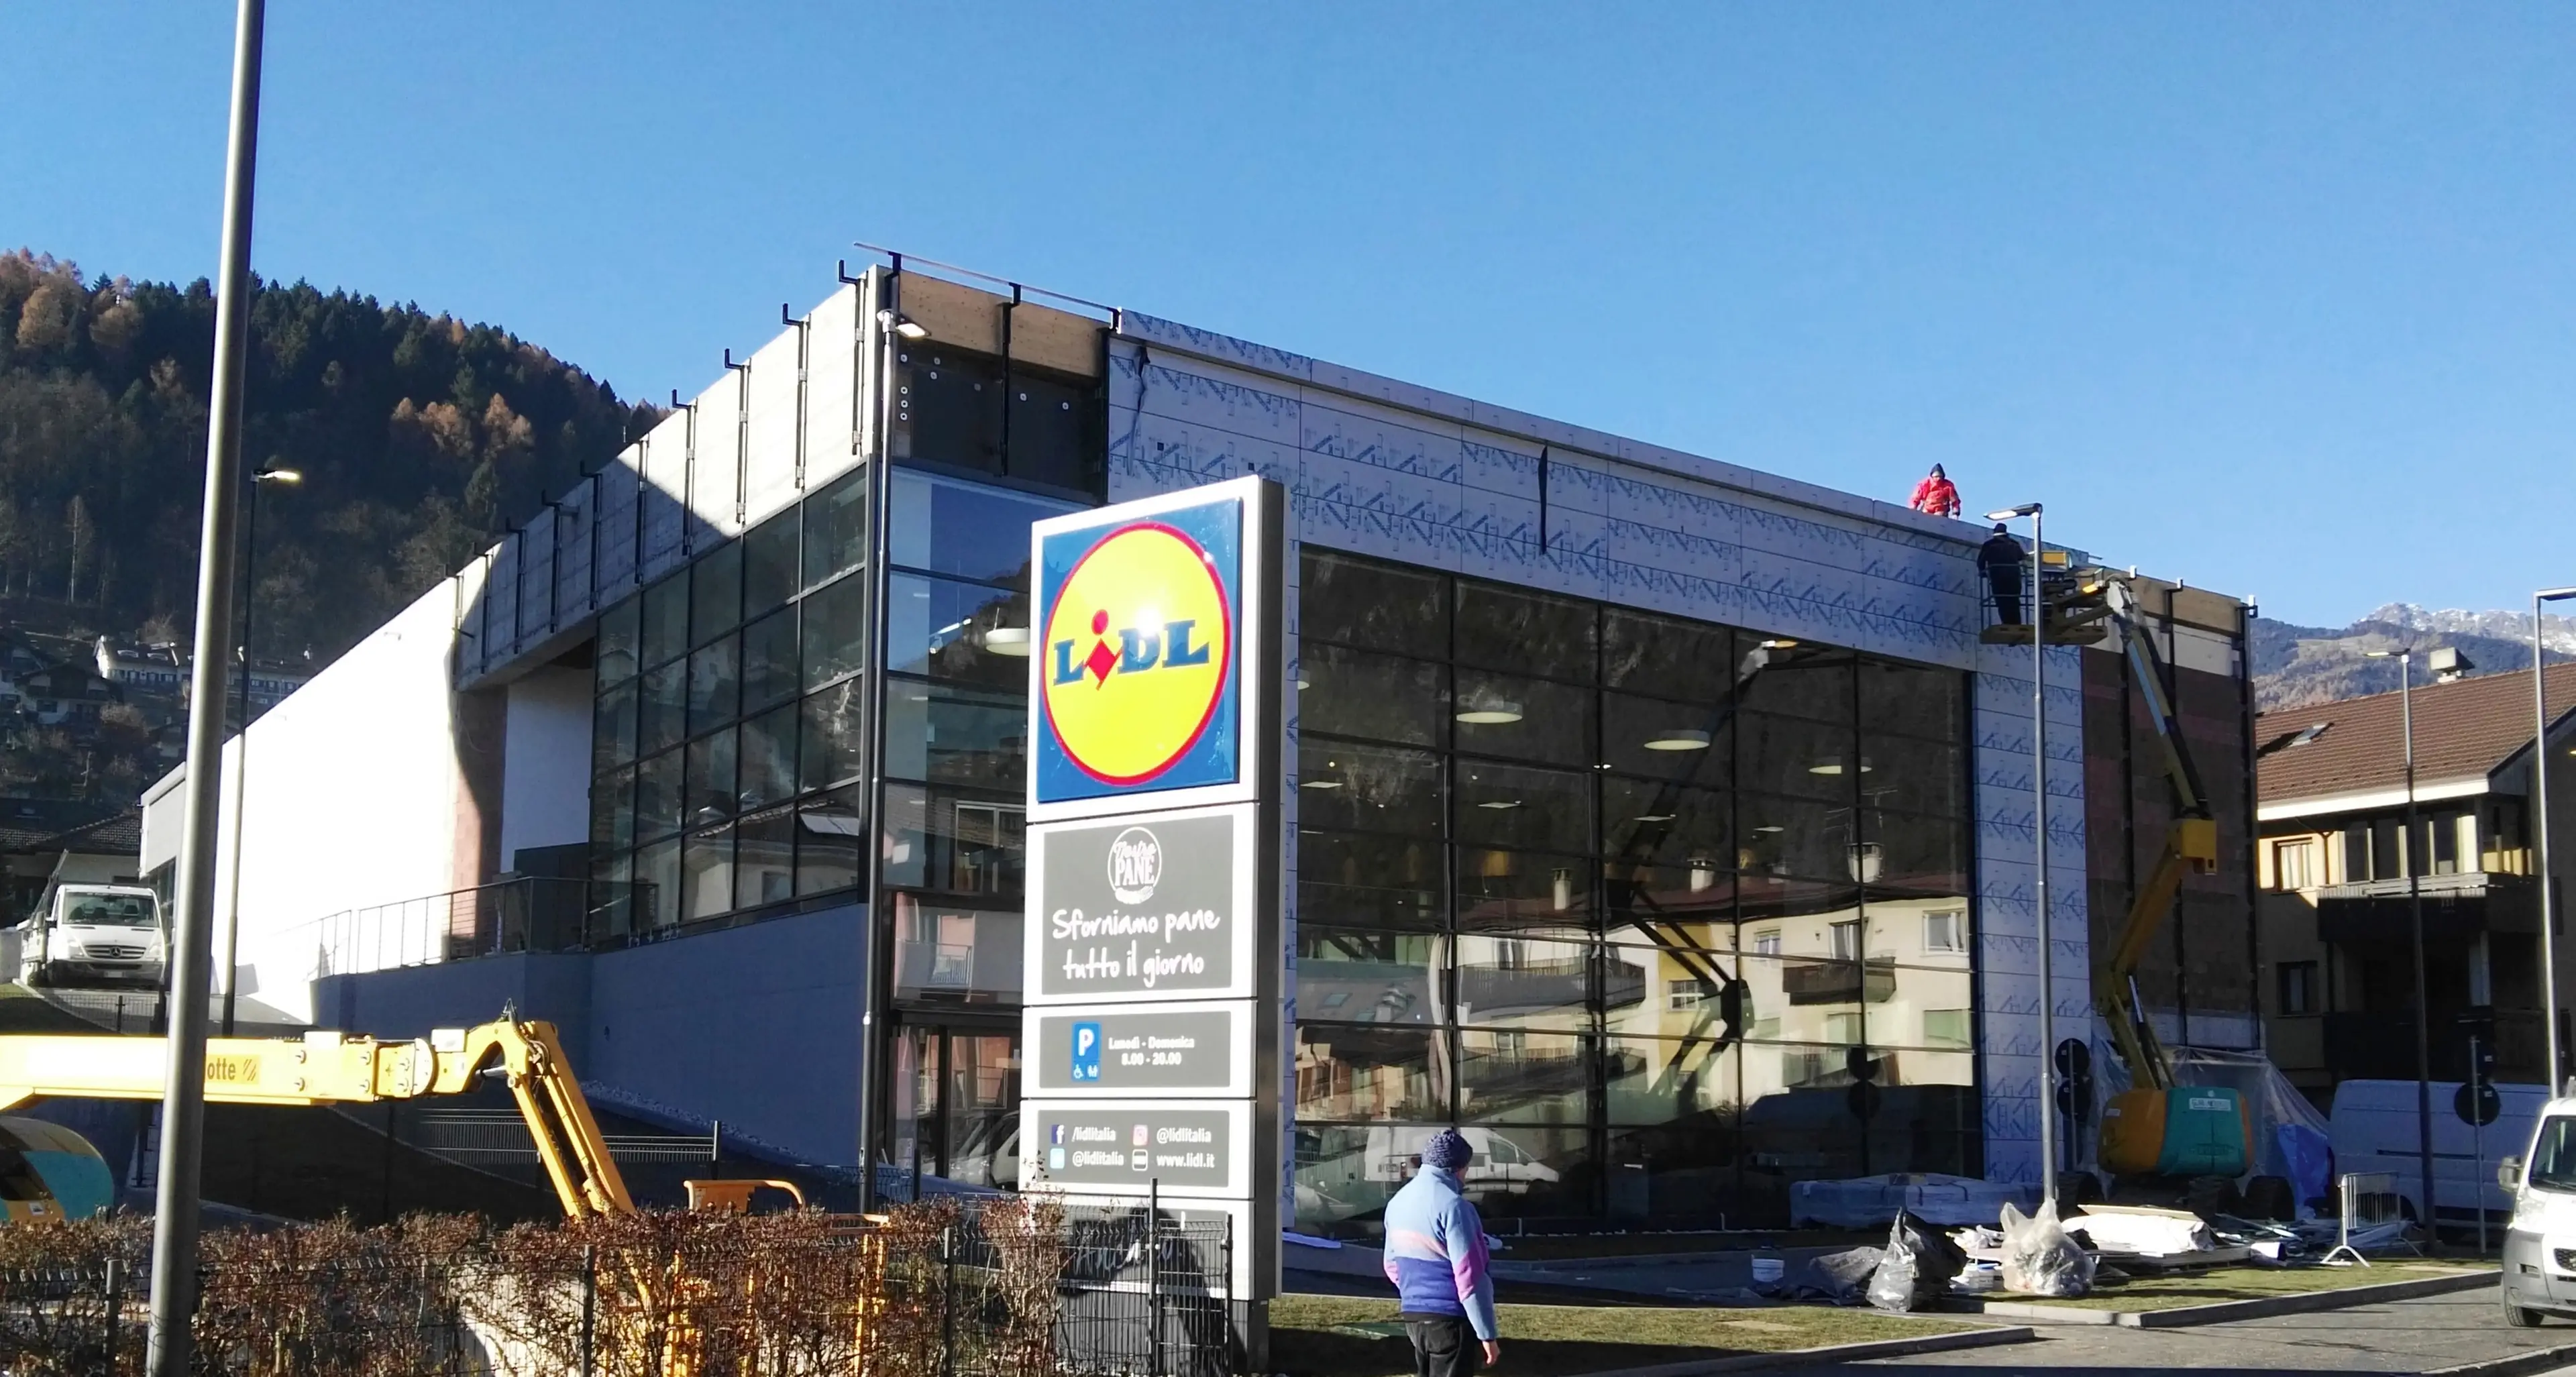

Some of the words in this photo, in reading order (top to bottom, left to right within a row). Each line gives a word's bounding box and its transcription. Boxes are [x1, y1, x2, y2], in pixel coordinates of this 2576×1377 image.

[1115, 855, 1155, 886] PANE
[1052, 909, 1159, 940] Sforniamo
[1165, 908, 1220, 942] pane
[1063, 947, 1120, 981] tutto
[1127, 940, 1137, 977] il
[1143, 950, 1204, 988] giorno
[1077, 1028, 1095, 1056] P
[1148, 1036, 1195, 1049] Domenica
[207, 1058, 236, 1081] otte
[1121, 1053, 1144, 1066] 8.00
[1152, 1052, 1182, 1065] 20.00
[1156, 1152, 1216, 1168] www.lidl.it
